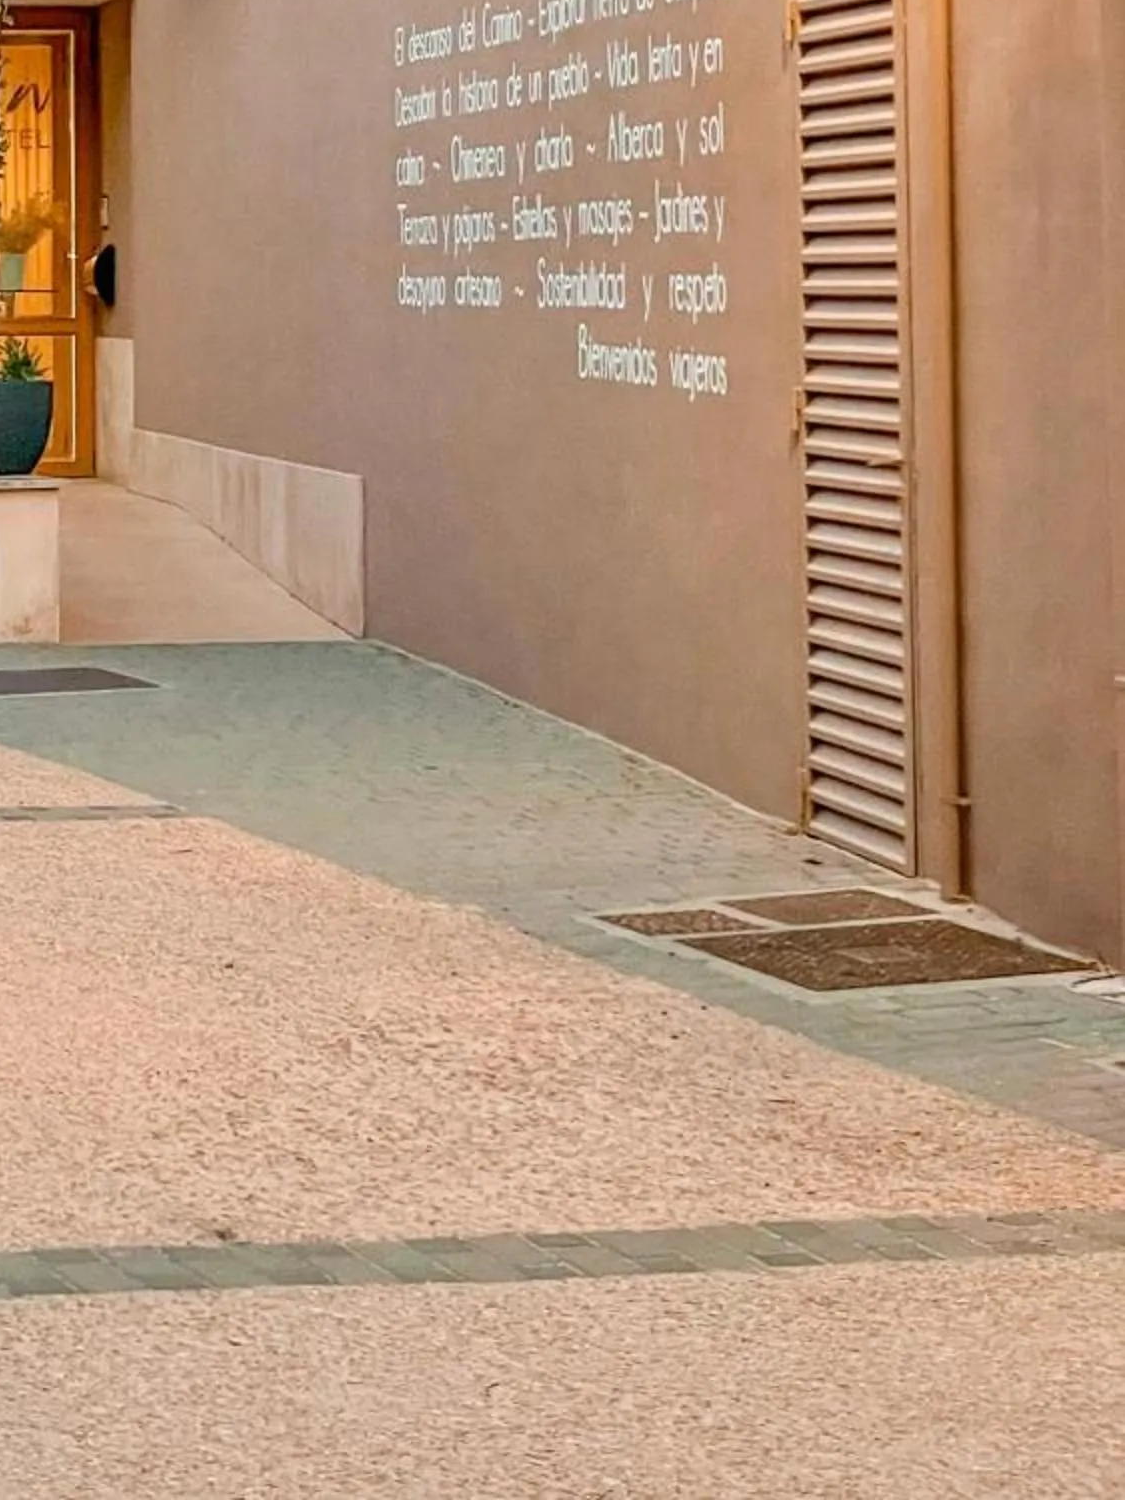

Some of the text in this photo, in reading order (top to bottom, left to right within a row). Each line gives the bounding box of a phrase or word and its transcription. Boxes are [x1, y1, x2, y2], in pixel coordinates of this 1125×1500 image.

[458, 7, 476, 52] del
[482, 2, 523, 48] Camino
[506, 61, 523, 108] de
[528, 70, 542, 104] un
[548, 52, 590, 111] pueblo
[606, 38, 639, 89] Vida
[648, 32, 682, 83] lenta
[688, 41, 700, 89] y
[704, 37, 724, 74] en
[450, 135, 506, 183] Chimenea
[516, 140, 526, 186] y
[535, 123, 573, 173] charla
[607, 110, 664, 162] Alberca
[676, 117, 689, 167] y
[699, 101, 725, 155] sol
[397, 203, 438, 245] Terraza
[442, 213, 451, 254] y
[512, 192, 559, 241] Estrellas
[563, 203, 573, 249] y
[578, 194, 634, 247] masajes
[653, 179, 709, 244] Jardines
[713, 195, 725, 244] y
[537, 257, 626, 310] Sostenibilidad
[641, 274, 654, 323] y
[668, 261, 728, 324] respeto
[577, 323, 728, 402] Bienvenidos viajeros
